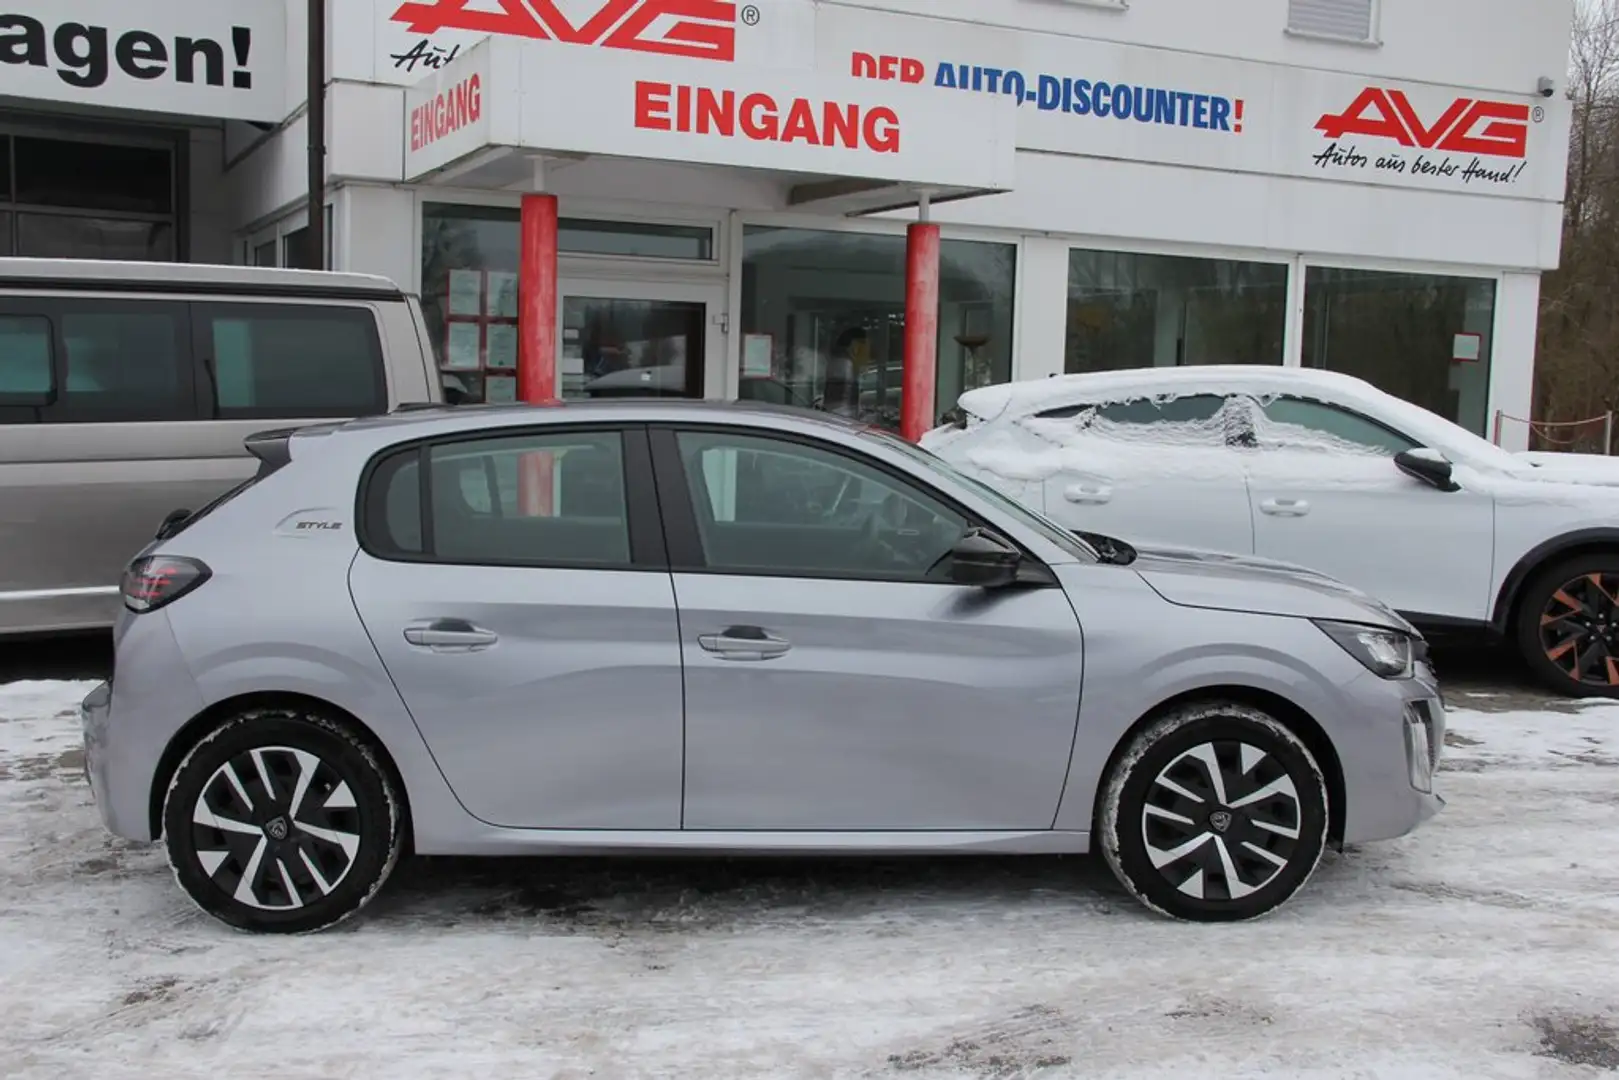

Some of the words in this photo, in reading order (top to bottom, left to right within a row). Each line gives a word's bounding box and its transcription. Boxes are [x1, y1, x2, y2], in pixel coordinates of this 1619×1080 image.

[411, 73, 480, 152] EINGANG
[635, 81, 899, 153] EINGANG
[934, 62, 1244, 133] AUTO-DISCOUNTER!
[1313, 87, 1529, 158] AVG
[1313, 142, 1368, 169] Autos
[1375, 154, 1405, 174] aus
[1411, 159, 1460, 178] bester
[1461, 157, 1527, 184] Hand!
